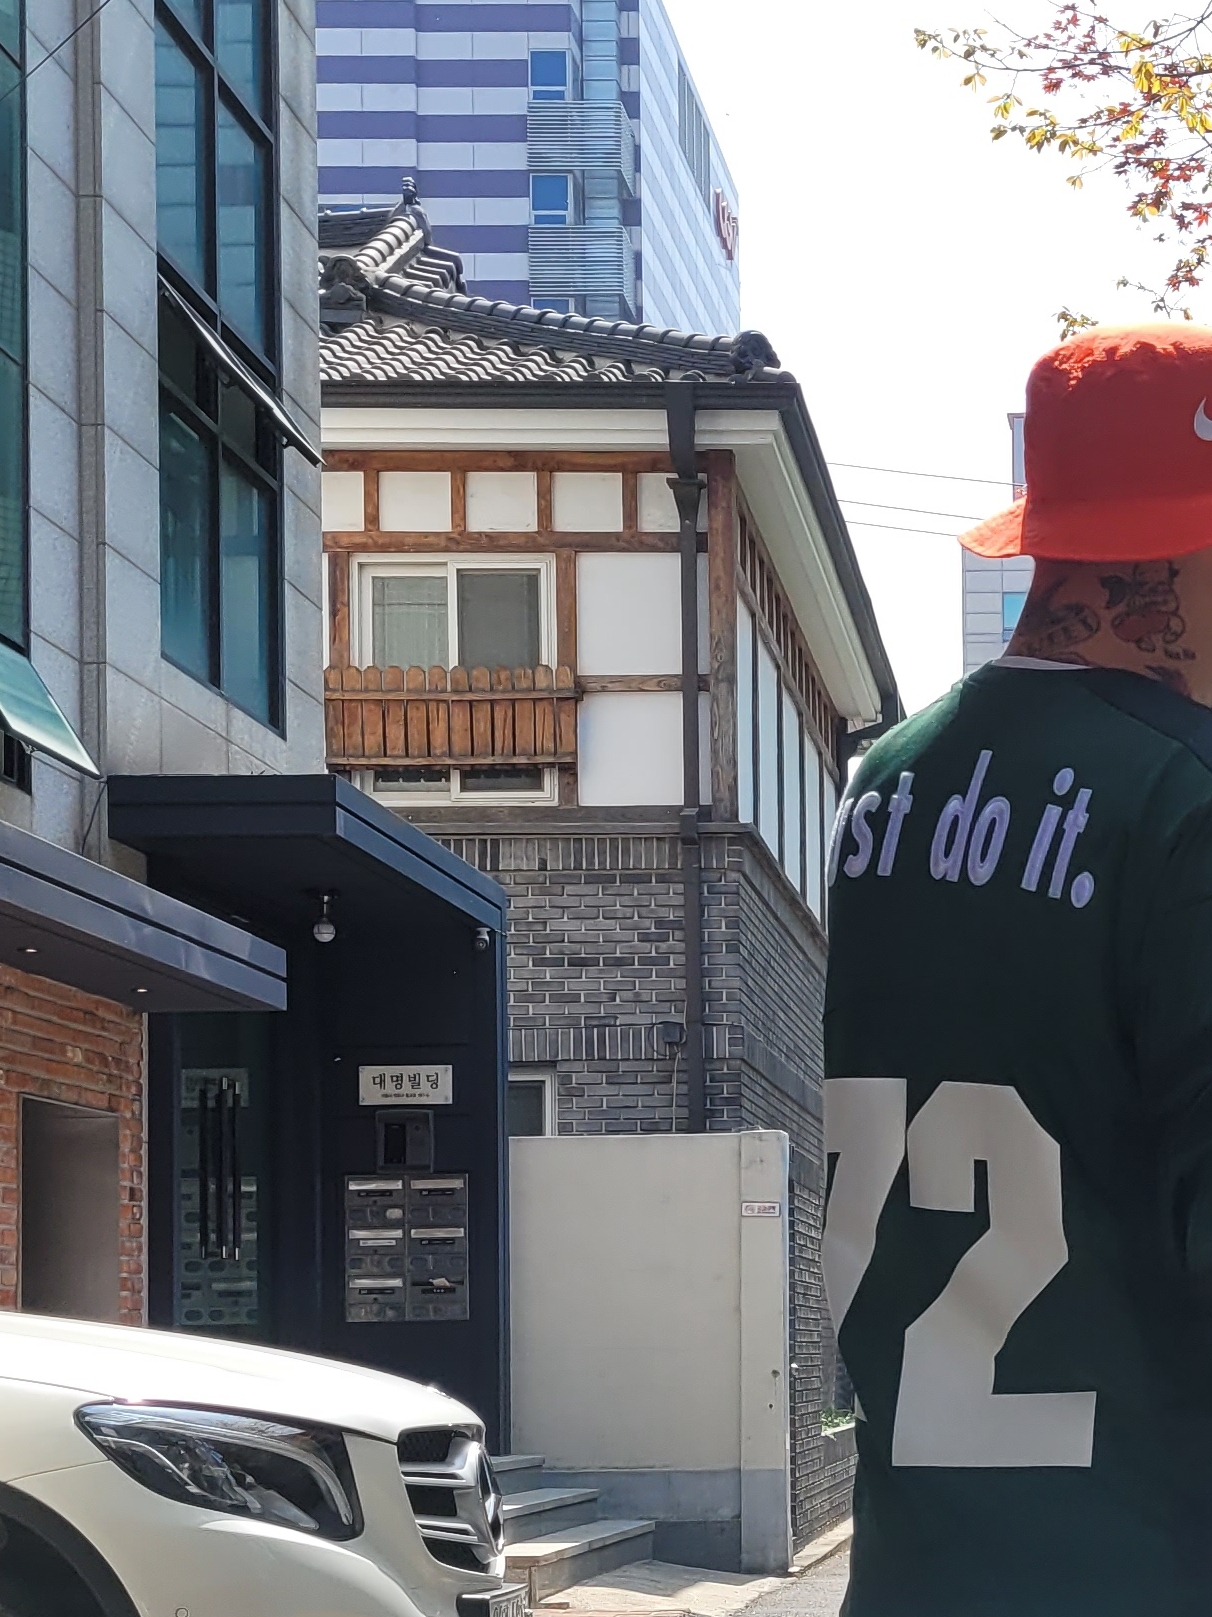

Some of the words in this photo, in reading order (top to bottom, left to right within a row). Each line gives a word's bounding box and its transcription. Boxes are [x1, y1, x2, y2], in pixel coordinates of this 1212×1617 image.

[930, 750, 1011, 886] do
[1020, 767, 1095, 908] it.
[371, 1072, 439, 1090] 대명빌딩
[821, 1077, 1097, 1468] 72
